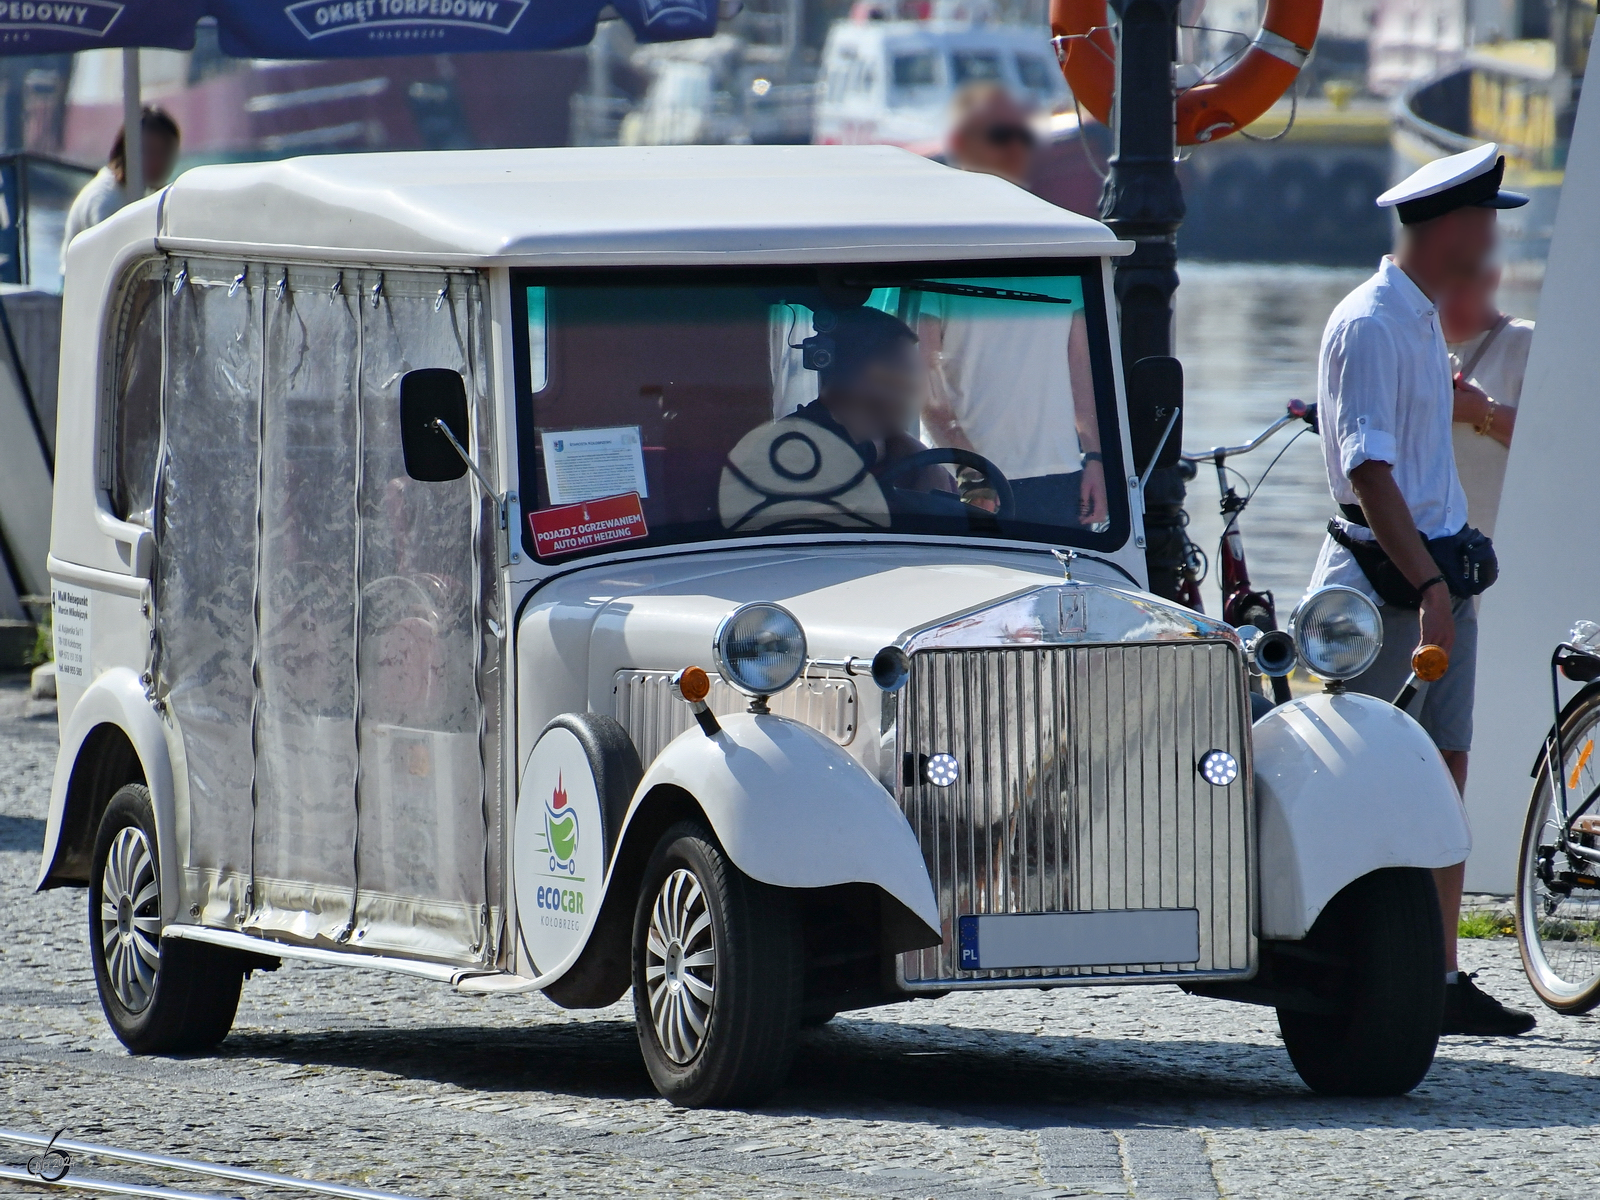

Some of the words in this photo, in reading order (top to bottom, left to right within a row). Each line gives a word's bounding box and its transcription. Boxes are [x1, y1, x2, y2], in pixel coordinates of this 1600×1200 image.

[315, 0, 376, 25] OKRĘT
[381, 0, 499, 20] TORPEDOWY
[537, 527, 571, 542] POJAZD
[572, 526, 578, 535] Z
[578, 513, 642, 533] OGRZEWANIEM
[553, 538, 577, 550] AUTO
[577, 534, 593, 545] MIT
[593, 527, 632, 542] HEIZUNG
[540, 915, 580, 931] KOŁOBRZEG
[962, 949, 978, 961] PL
